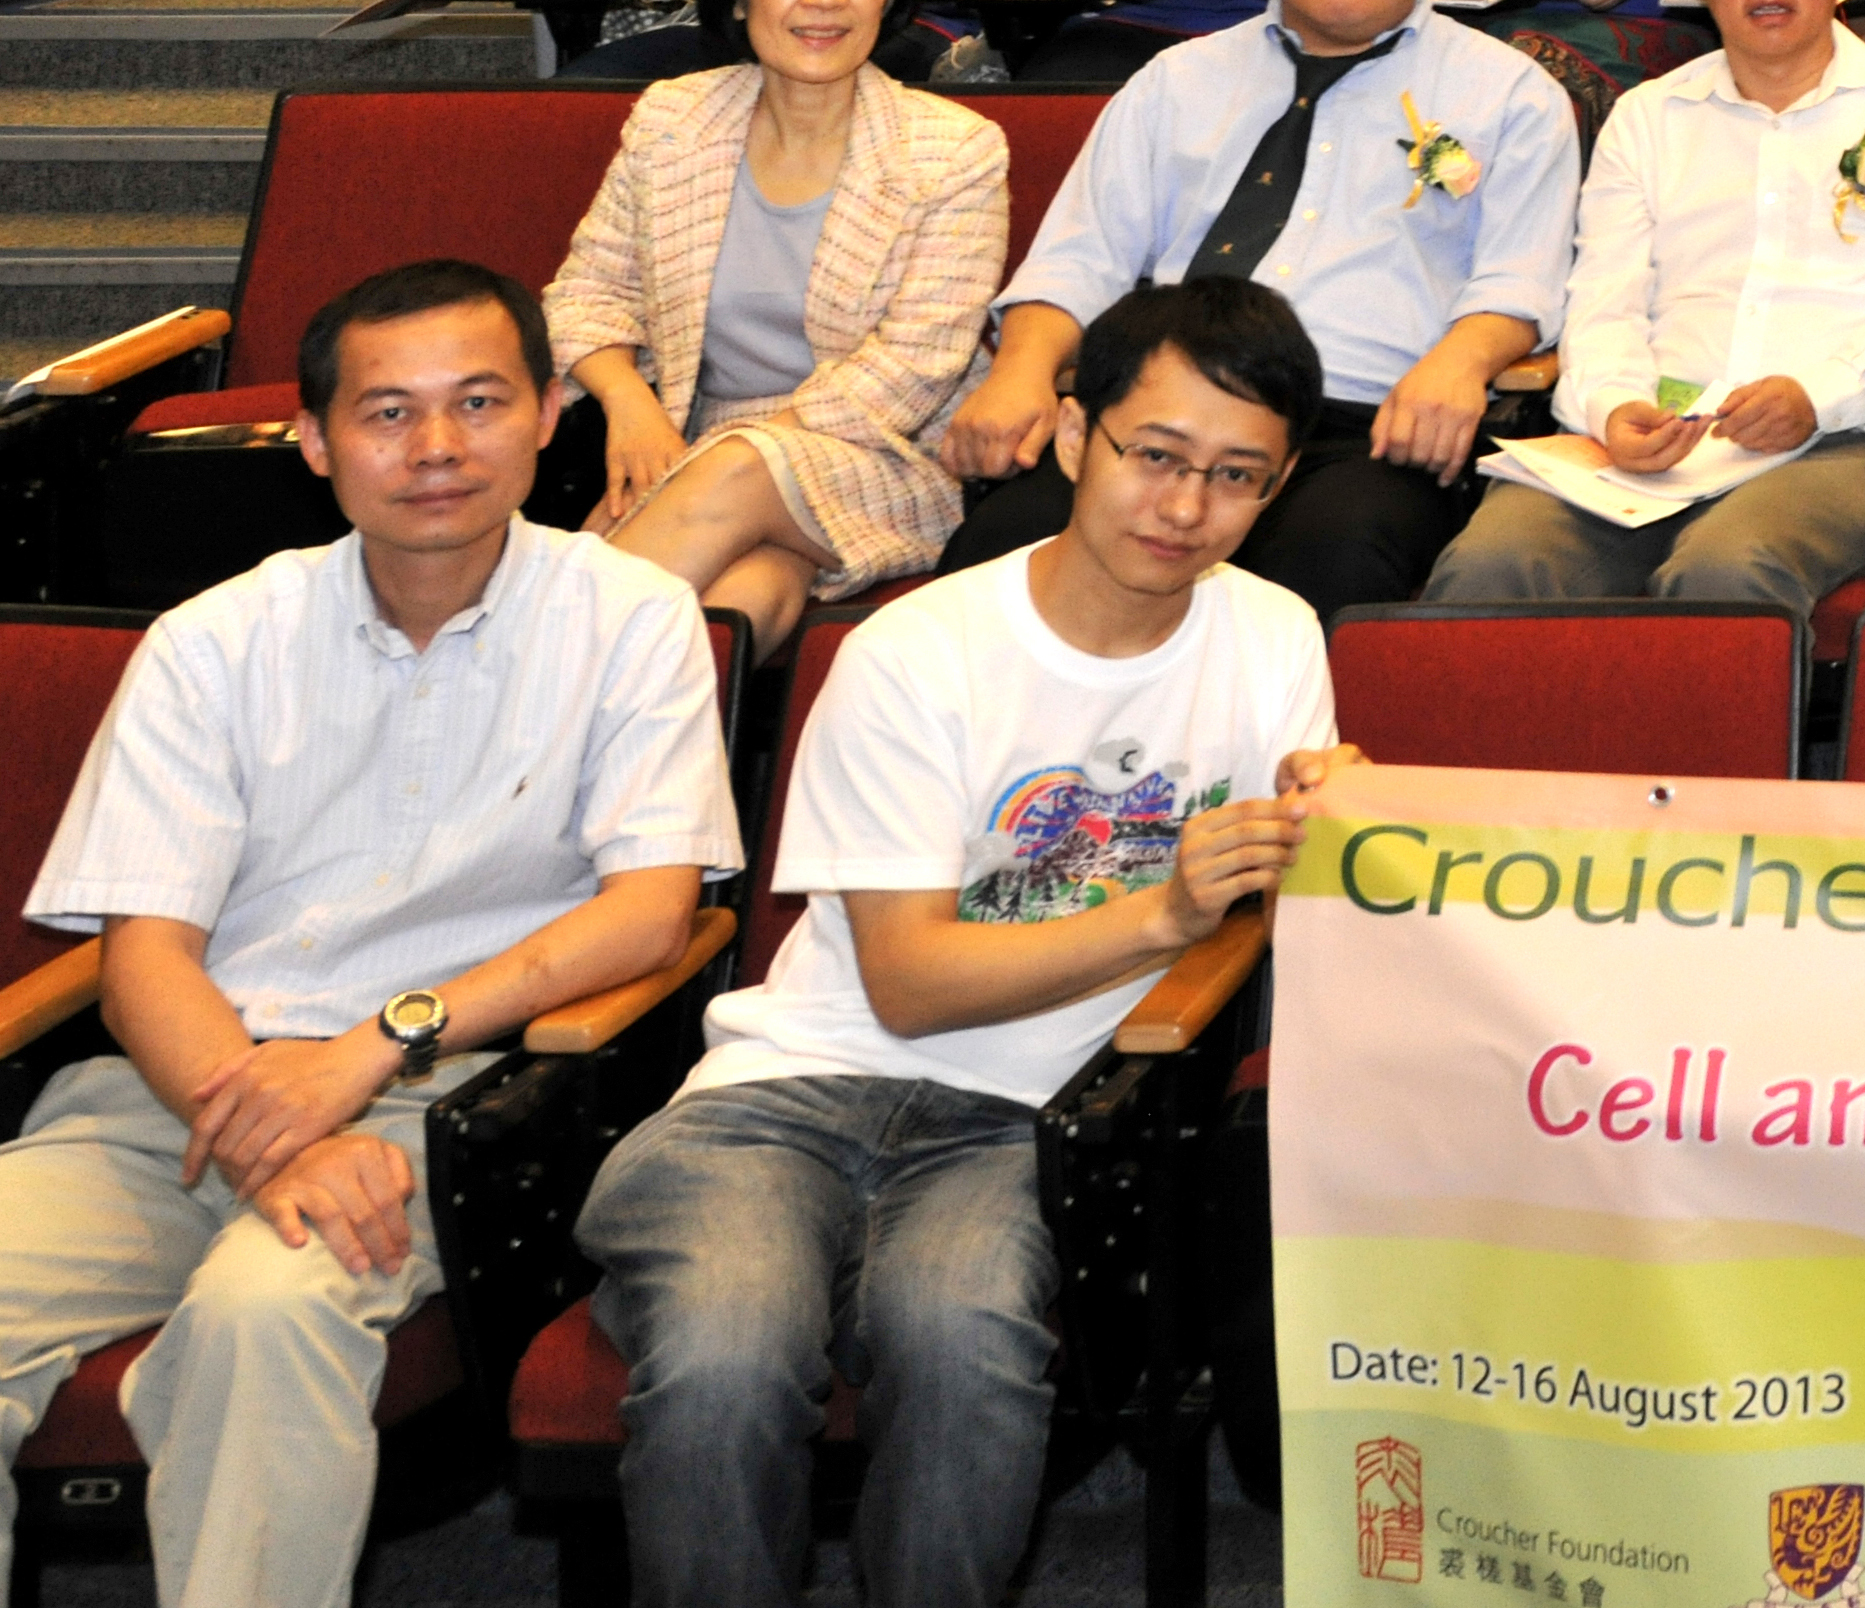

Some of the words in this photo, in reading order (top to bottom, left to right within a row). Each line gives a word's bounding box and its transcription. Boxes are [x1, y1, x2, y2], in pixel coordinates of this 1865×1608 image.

[1528, 1043, 1727, 1141] Cell
[1331, 1342, 1438, 1386] Date:
[1452, 1353, 1557, 1404] 12-16
[1569, 1369, 1717, 1428] August
[1733, 1373, 1847, 1420] 2013
[1437, 1506, 1540, 1553] Croucher
[1548, 1531, 1690, 1575] Foundation
